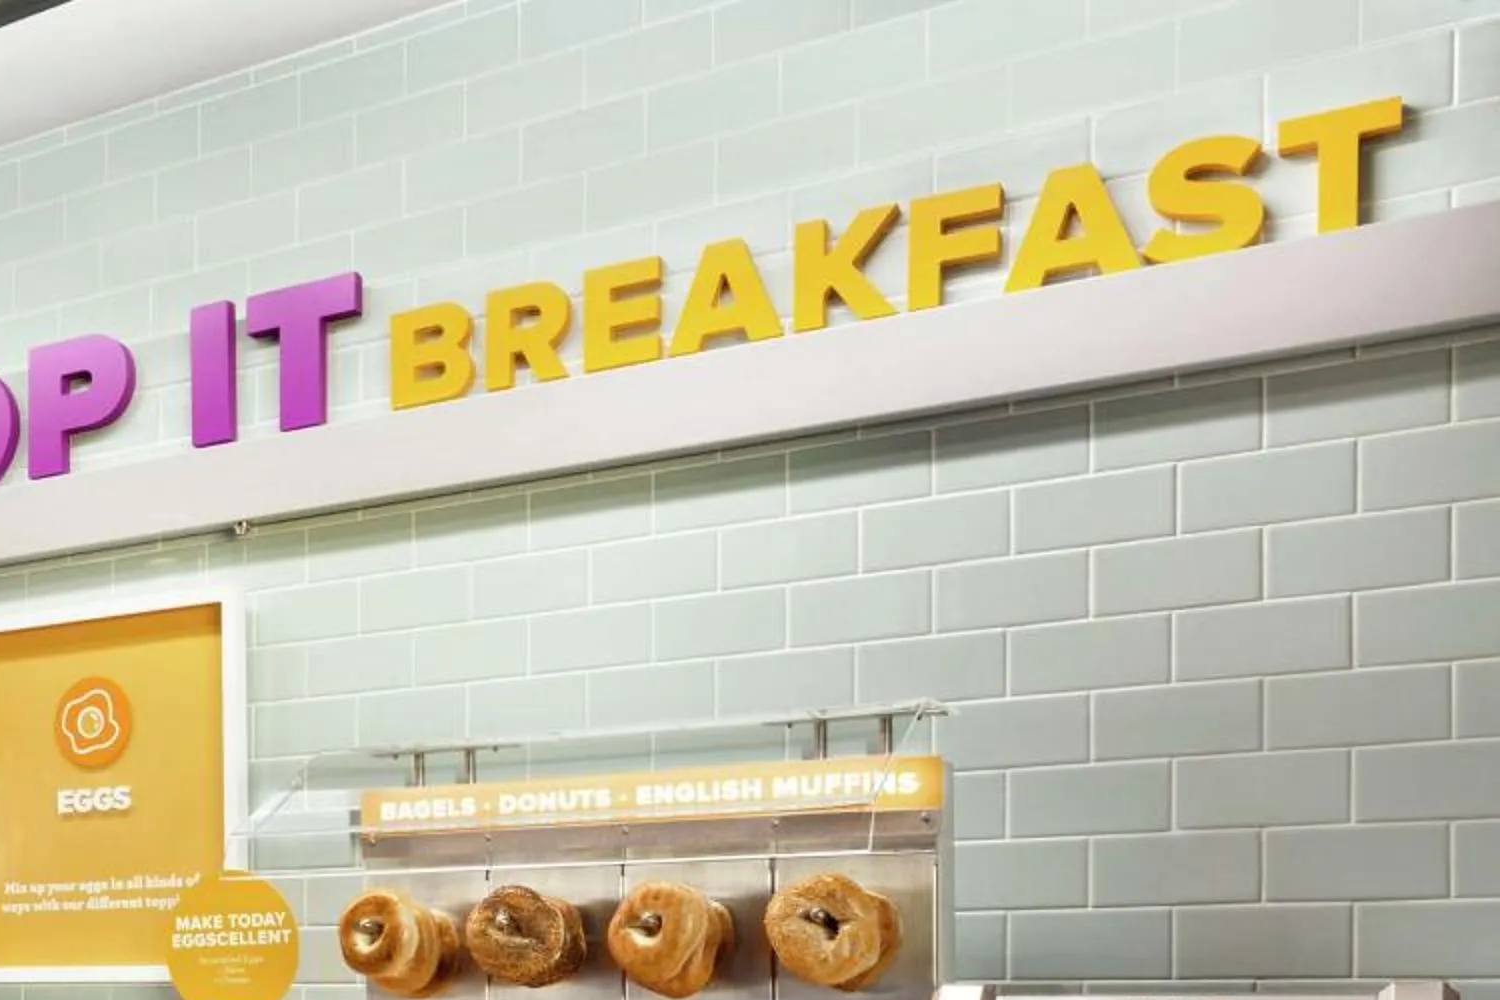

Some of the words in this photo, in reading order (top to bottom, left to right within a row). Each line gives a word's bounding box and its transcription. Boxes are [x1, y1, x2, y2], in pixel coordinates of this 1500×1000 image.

[190, 271, 363, 448] IT
[389, 95, 1408, 411] BREAKFAST
[57, 786, 132, 815] EGGS
[380, 797, 476, 821] BAGELS
[499, 788, 612, 815] DONUTS
[635, 777, 762, 806] ENGLISH
[771, 771, 921, 798] MUFFINS
[175, 913, 224, 931] MAKE
[228, 911, 286, 929] TODAY
[171, 928, 292, 949] EGGSCELLENT
